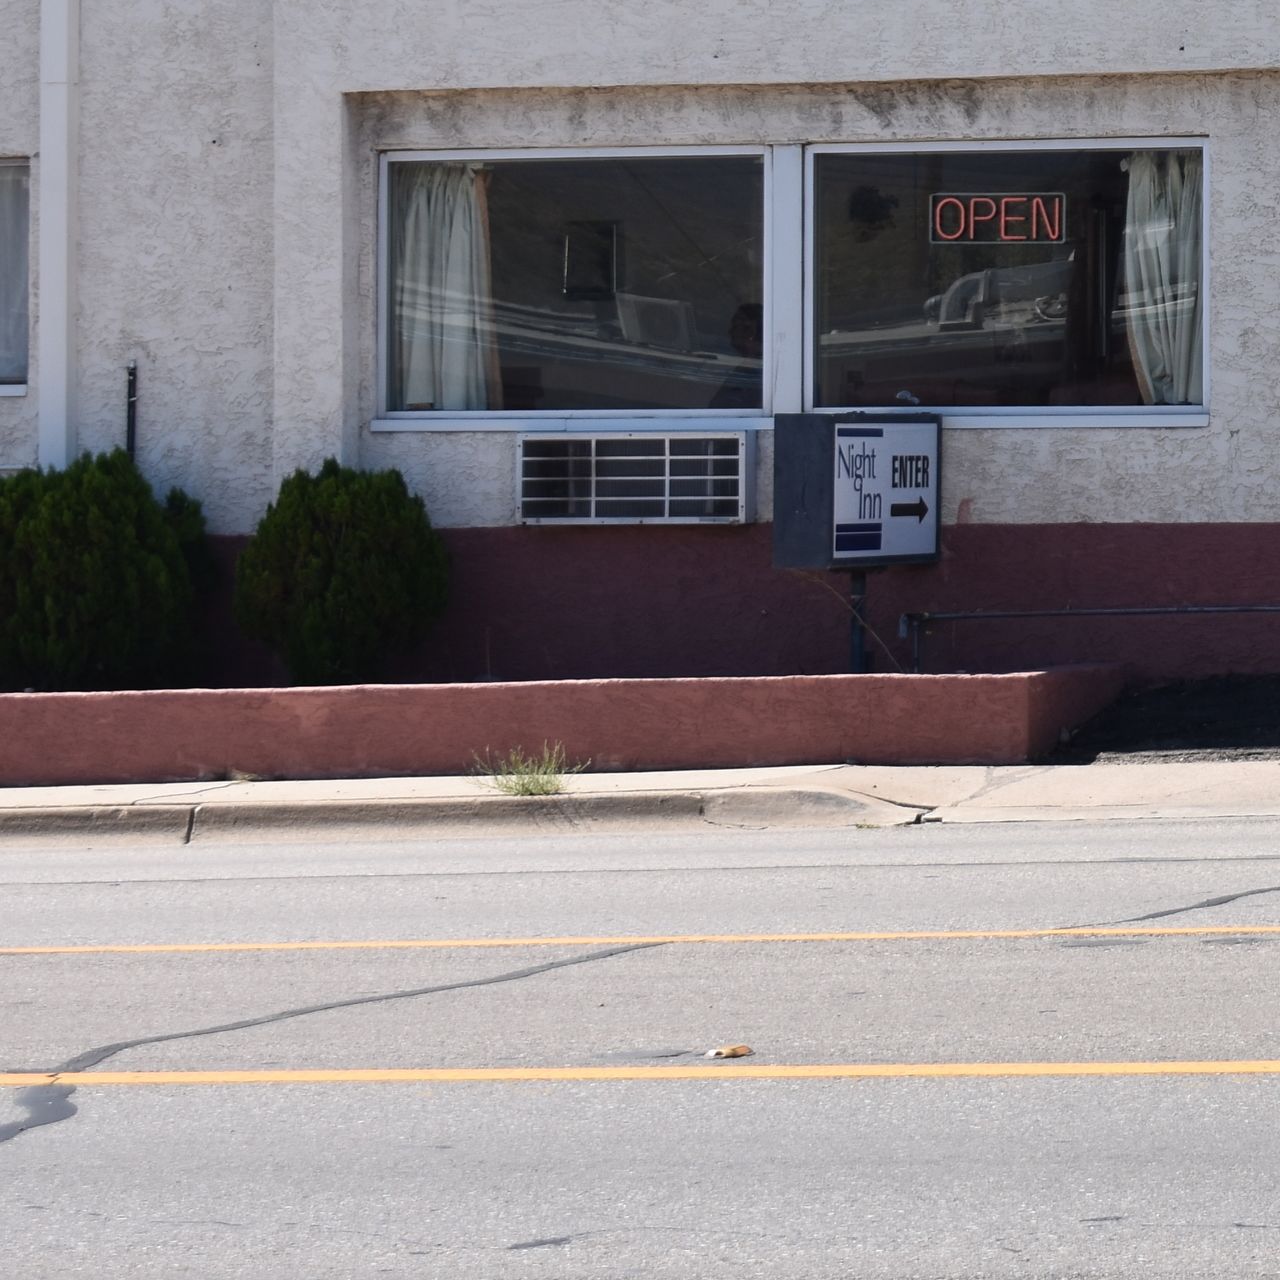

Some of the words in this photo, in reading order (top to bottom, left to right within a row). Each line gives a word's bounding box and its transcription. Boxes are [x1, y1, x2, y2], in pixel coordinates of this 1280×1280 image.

[935, 197, 1060, 240] OPEN
[837, 441, 877, 492] Night
[891, 455, 930, 488] ENTER
[858, 484, 883, 519] Inn
